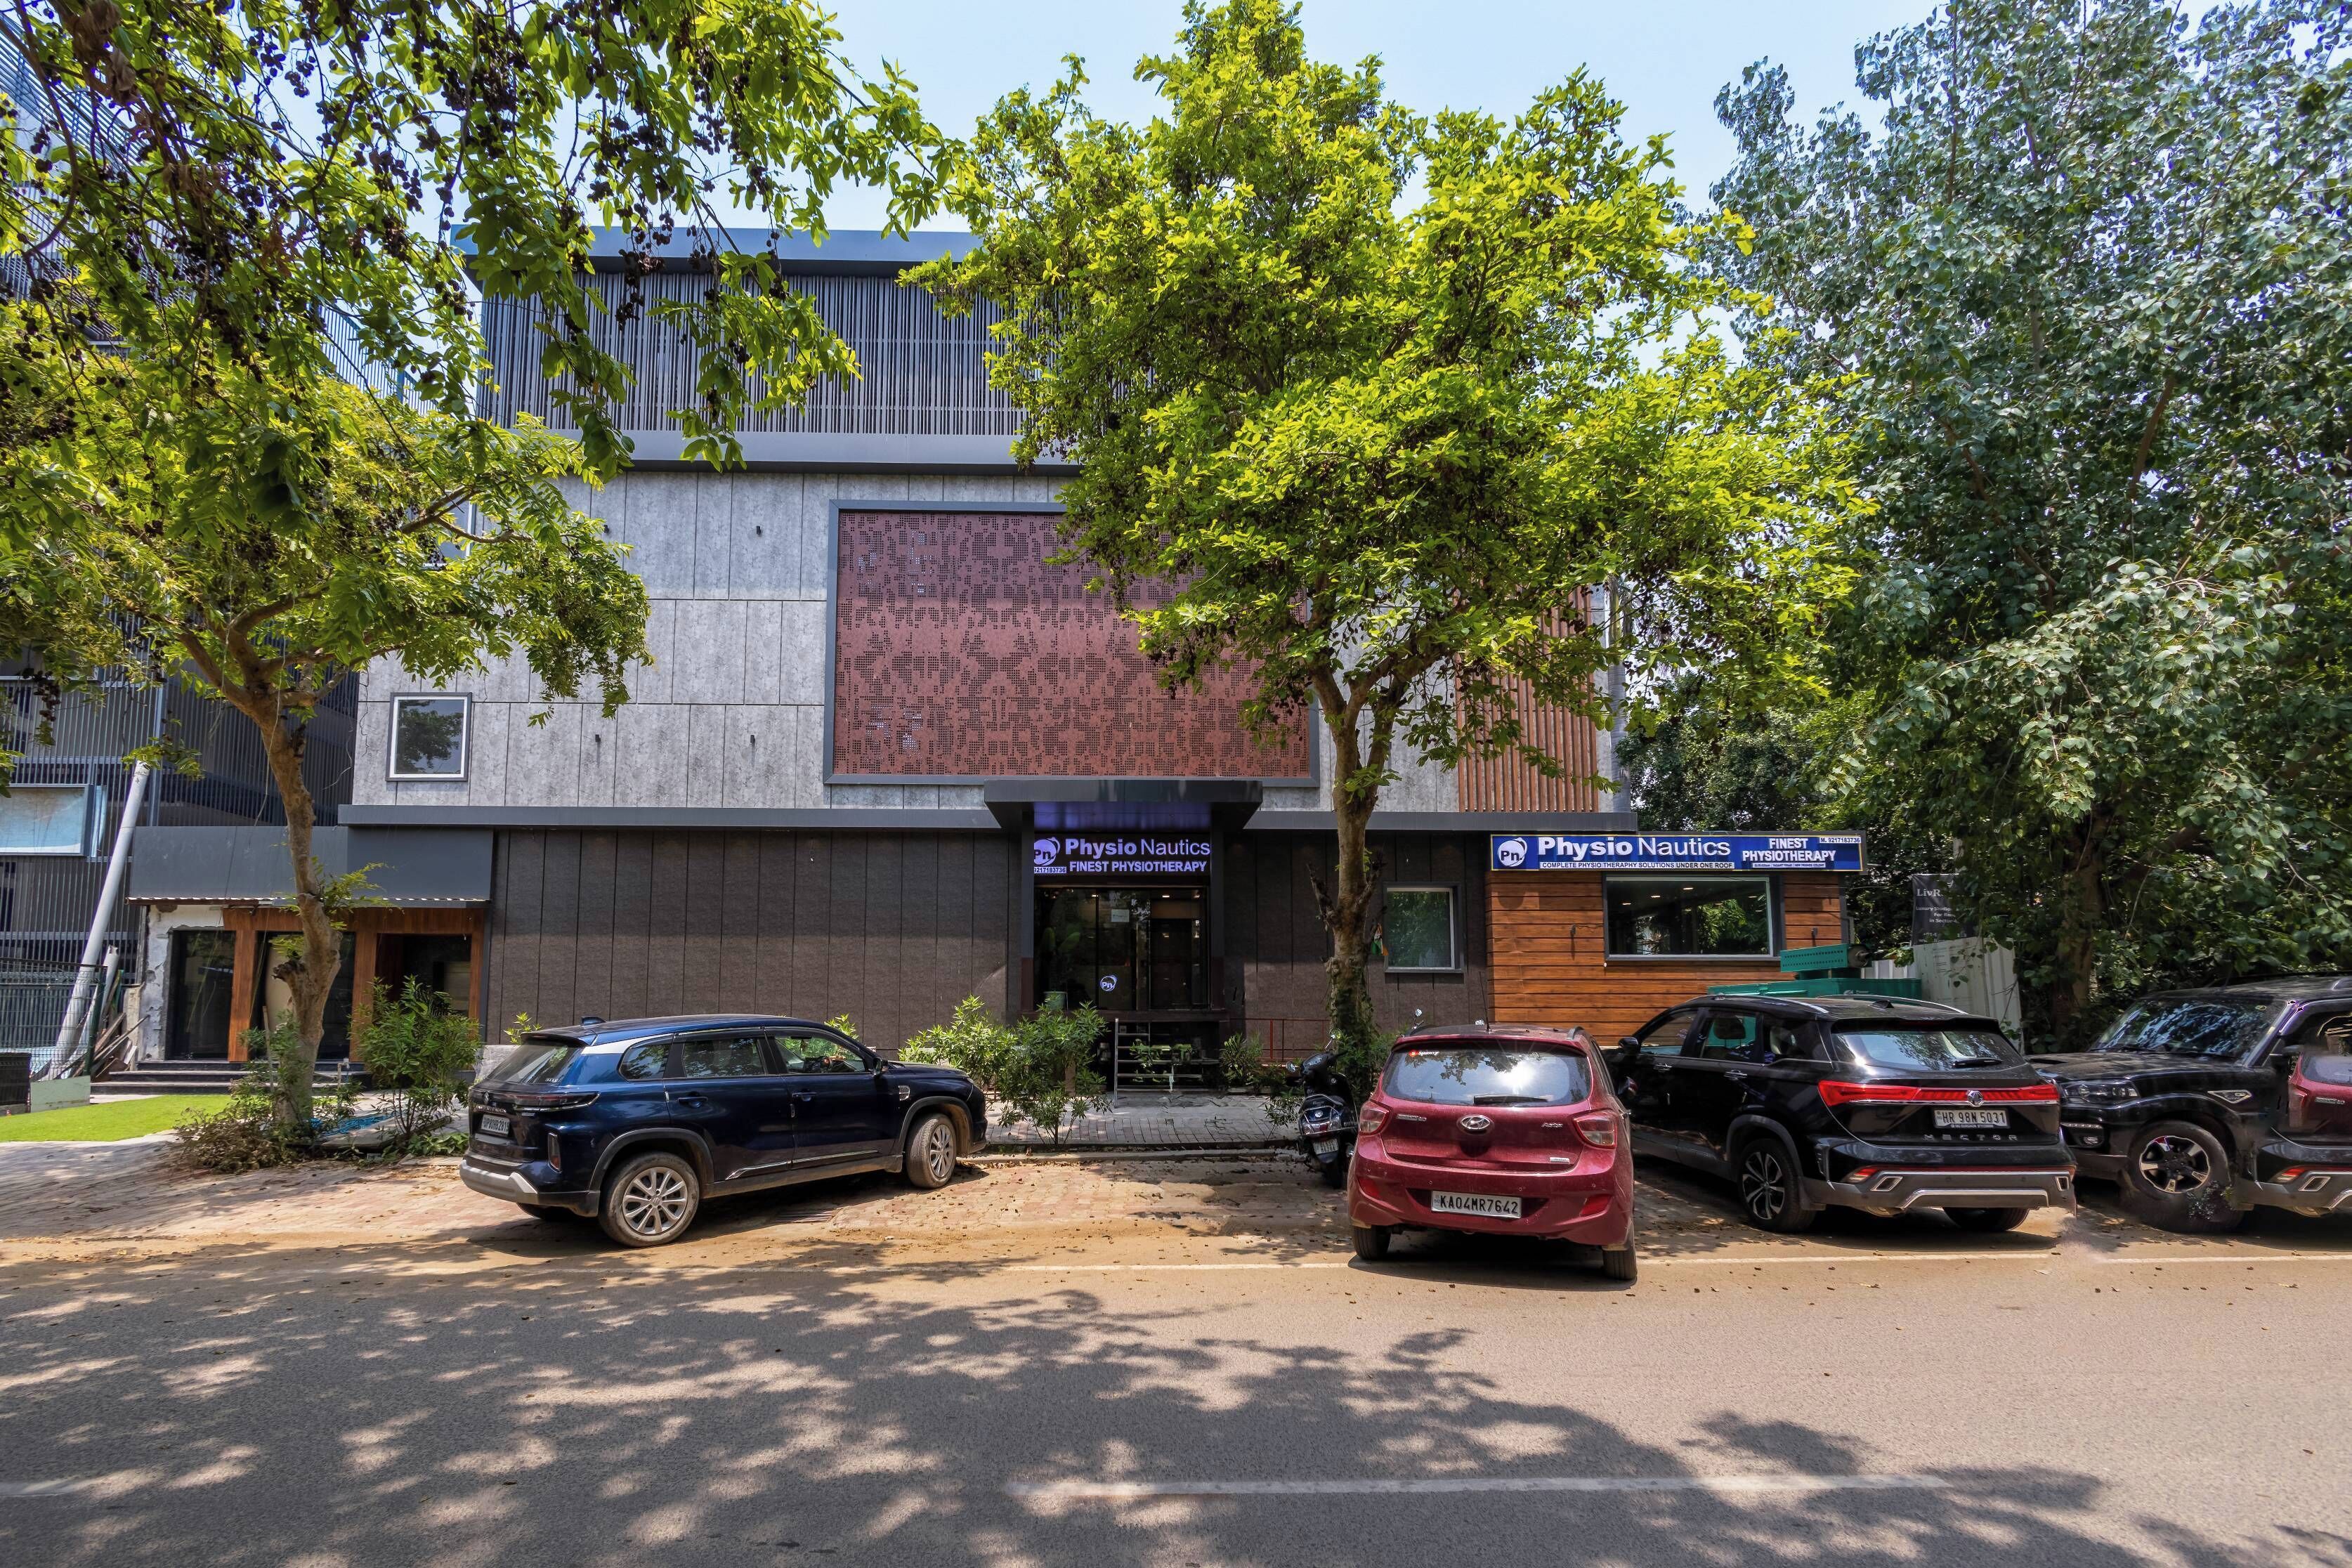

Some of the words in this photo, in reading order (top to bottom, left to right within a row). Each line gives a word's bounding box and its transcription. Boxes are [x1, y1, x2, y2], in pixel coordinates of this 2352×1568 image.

[1065, 837, 1137, 859] Physio
[1141, 838, 1211, 855] Nautics
[1538, 836, 1633, 861] Physio
[1638, 837, 1732, 856] Nautics
[1769, 838, 1808, 849] FINEST
[1742, 850, 1836, 861] PHYSIOTHERAPY
[1069, 861, 1109, 872] FINEST
[1112, 861, 1208, 873] PHYSIOTHERAPY
[1942, 1111, 1954, 1124] HR
[1958, 1111, 1977, 1123] 98N
[1980, 1111, 2006, 1123] 5031
[1439, 1195, 1518, 1215] KA04MR7642
